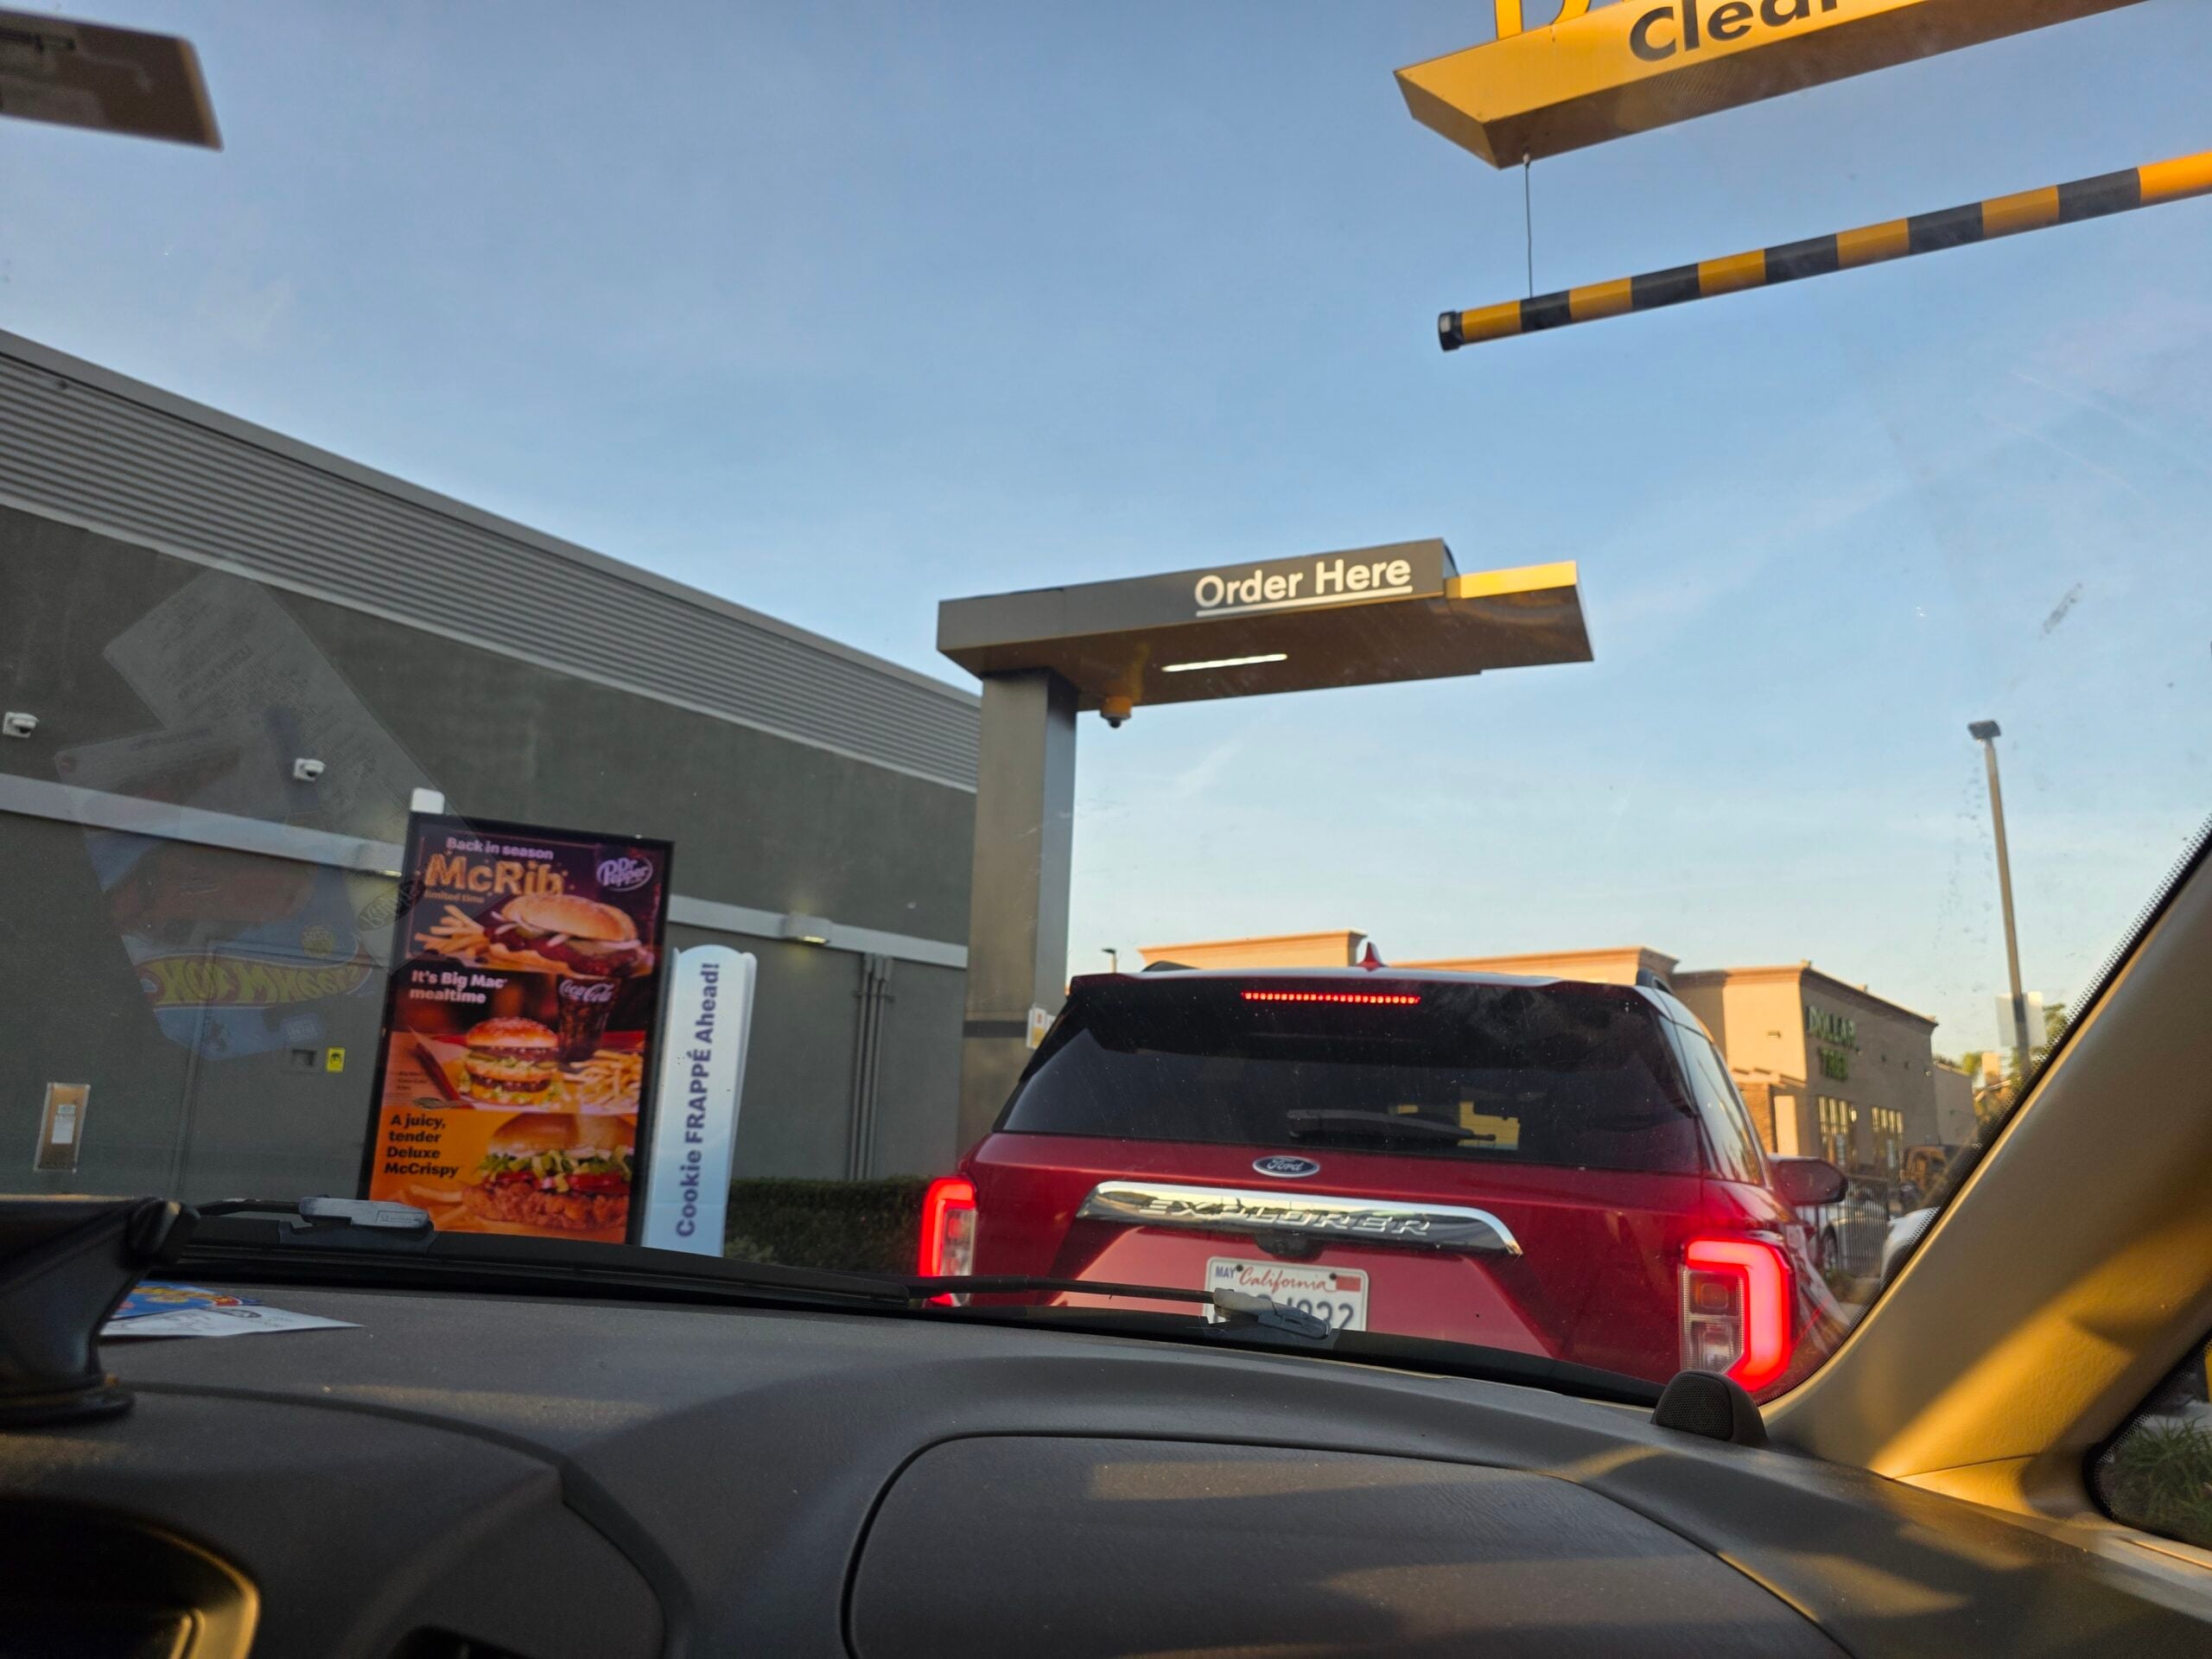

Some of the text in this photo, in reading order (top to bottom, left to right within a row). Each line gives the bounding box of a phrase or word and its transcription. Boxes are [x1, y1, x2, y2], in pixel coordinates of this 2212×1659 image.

[1629, 0, 1839, 62] Clea
[1195, 558, 1411, 607] Order Here
[445, 836, 554, 861] Back in season
[423, 853, 564, 895] McRib
[423, 889, 486, 905] limited time
[410, 969, 505, 989] It's Big Mac
[409, 988, 486, 1004] mealtime
[675, 963, 720, 1237] Cookie FRAPPÉ Ahead!
[390, 1113, 447, 1130] A juicy,
[389, 1129, 442, 1143] tender
[386, 1146, 441, 1159] Deluxe
[384, 1161, 460, 1179] McCrispy
[1267, 1158, 1305, 1172] Ford
[1139, 1198, 1431, 1236] EXPLORER
[1215, 1264, 1336, 1294] MAY California
